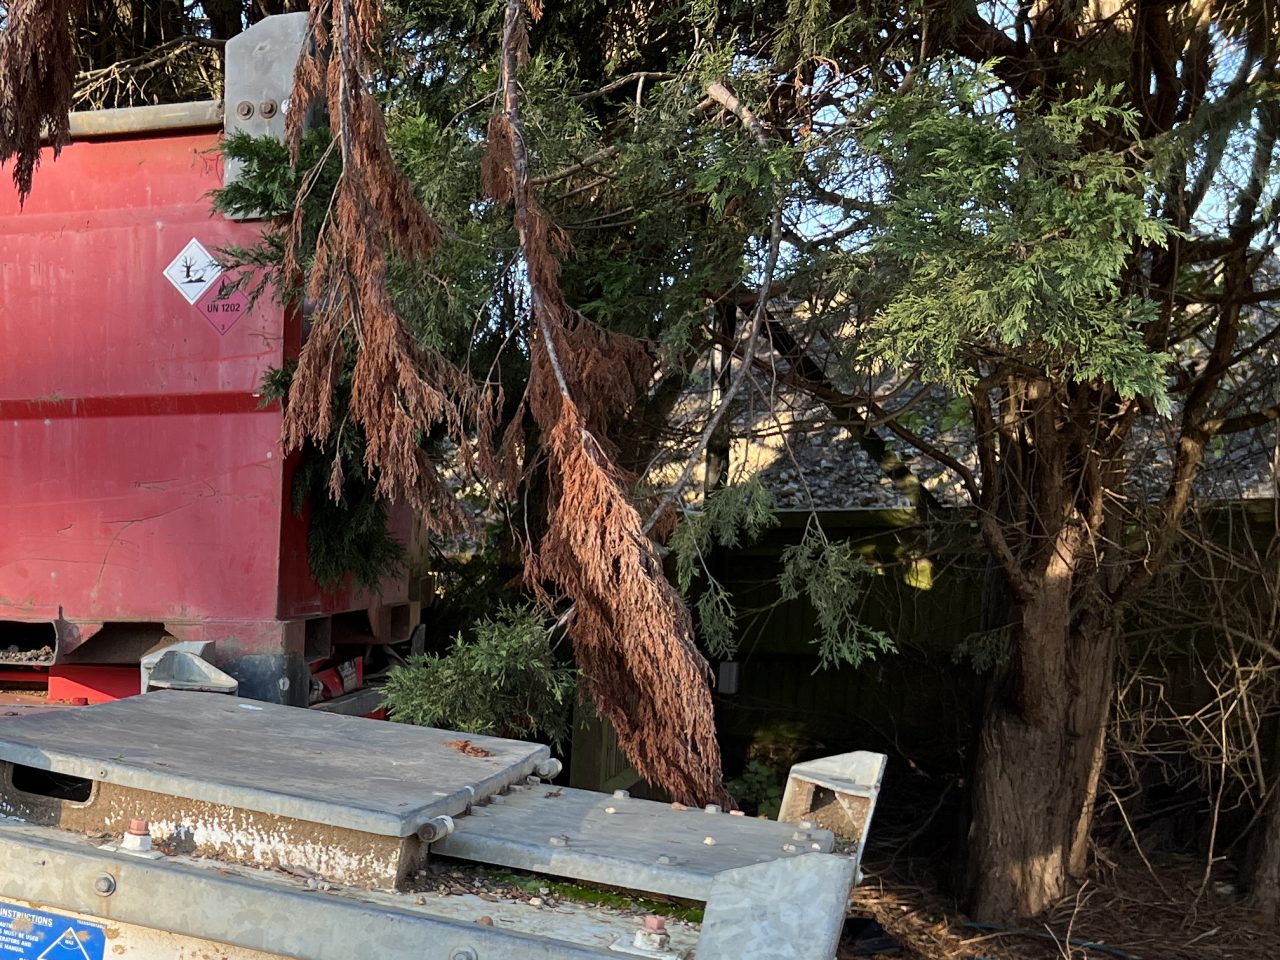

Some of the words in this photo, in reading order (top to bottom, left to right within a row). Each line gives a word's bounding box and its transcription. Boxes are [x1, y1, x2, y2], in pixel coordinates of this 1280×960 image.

[207, 304, 219, 313] UN
[221, 303, 241, 312] 1202
[0, 908, 53, 926] INSTRUCTIONS
